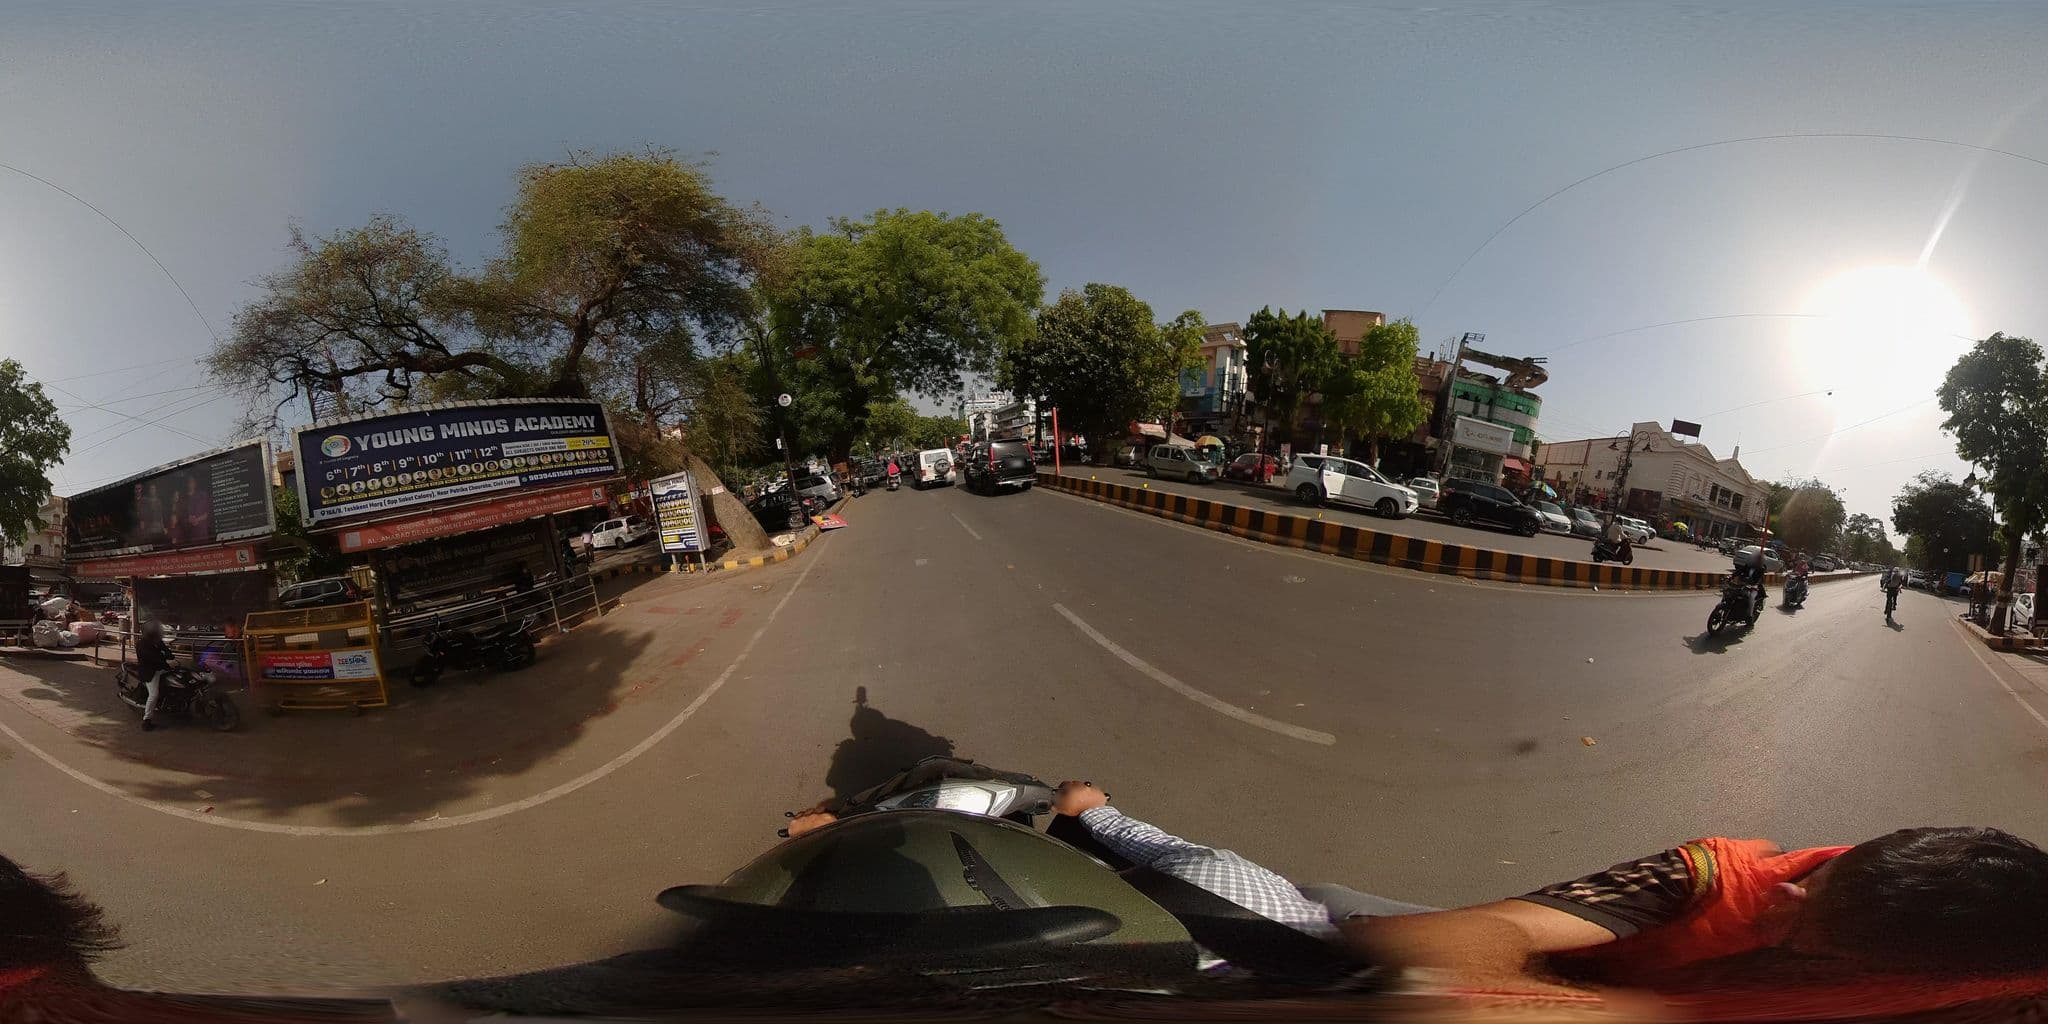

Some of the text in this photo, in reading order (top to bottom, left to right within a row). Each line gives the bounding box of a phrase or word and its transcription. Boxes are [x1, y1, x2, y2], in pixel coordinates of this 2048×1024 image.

[354, 416, 595, 451] YOUNG MINDS ACADEMY
[326, 469, 342, 481] 6th
[350, 464, 366, 477] 7th
[373, 459, 390, 473] 8th
[398, 456, 415, 468] 9th
[422, 451, 444, 465] 10th
[454, 448, 472, 460] 11th
[479, 445, 498, 457] 12th
